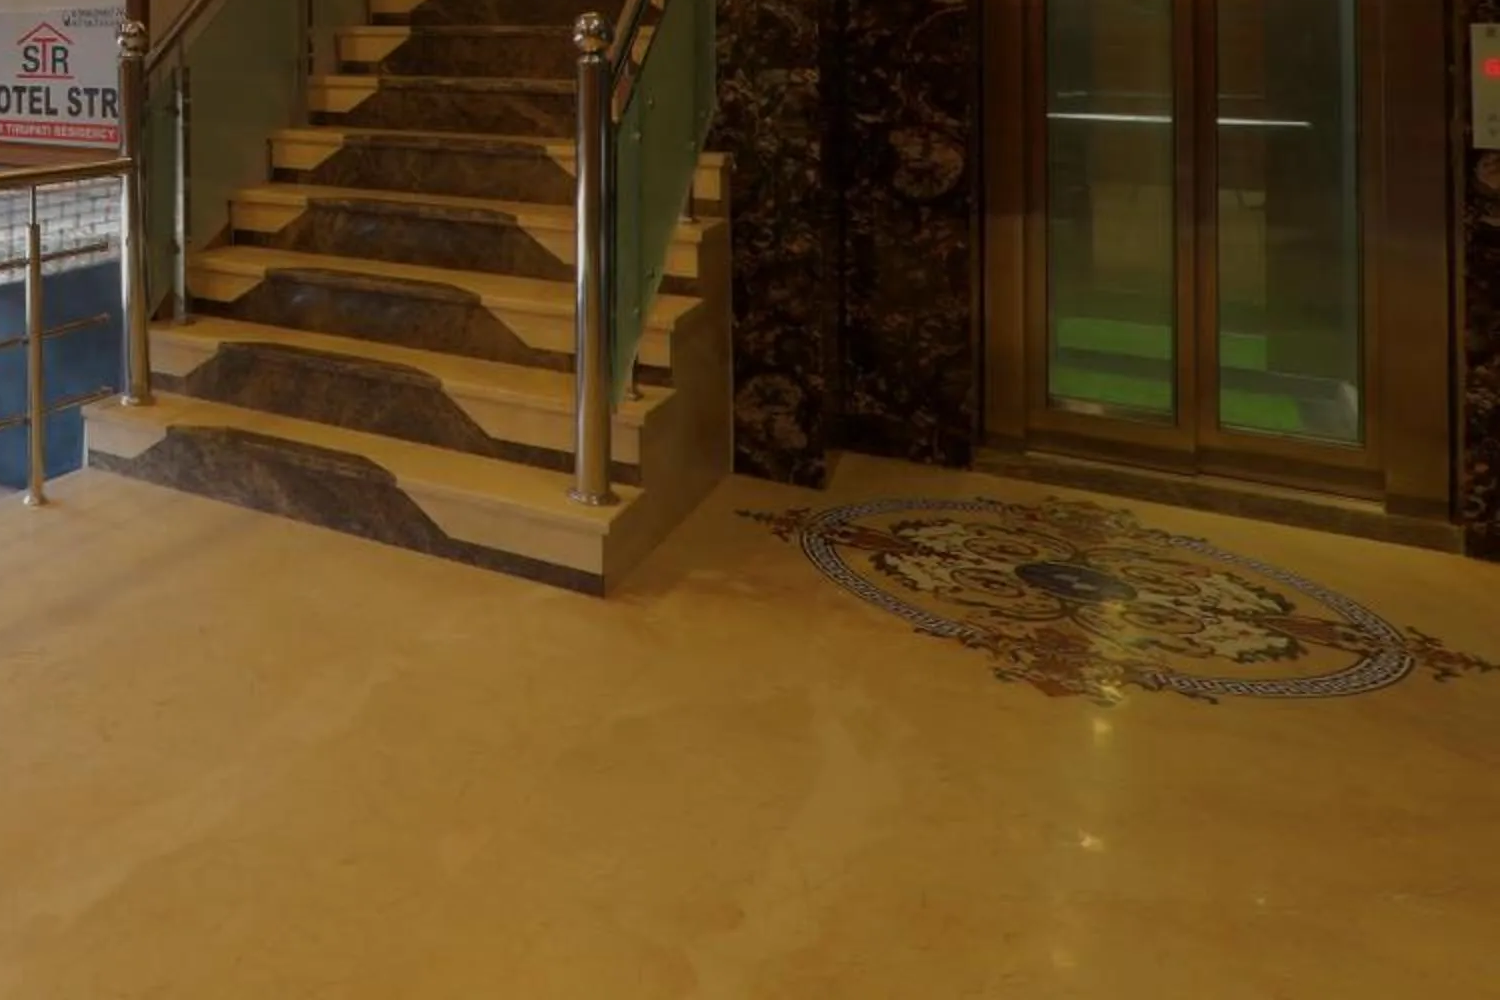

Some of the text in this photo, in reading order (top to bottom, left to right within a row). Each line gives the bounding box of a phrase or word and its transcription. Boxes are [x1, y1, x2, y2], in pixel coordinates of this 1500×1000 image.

[22, 38, 69, 74] STR
[67, 87, 119, 118] STR
[6, 123, 51, 137] TIRUPATI
[54, 124, 117, 140] RESIDENCY
